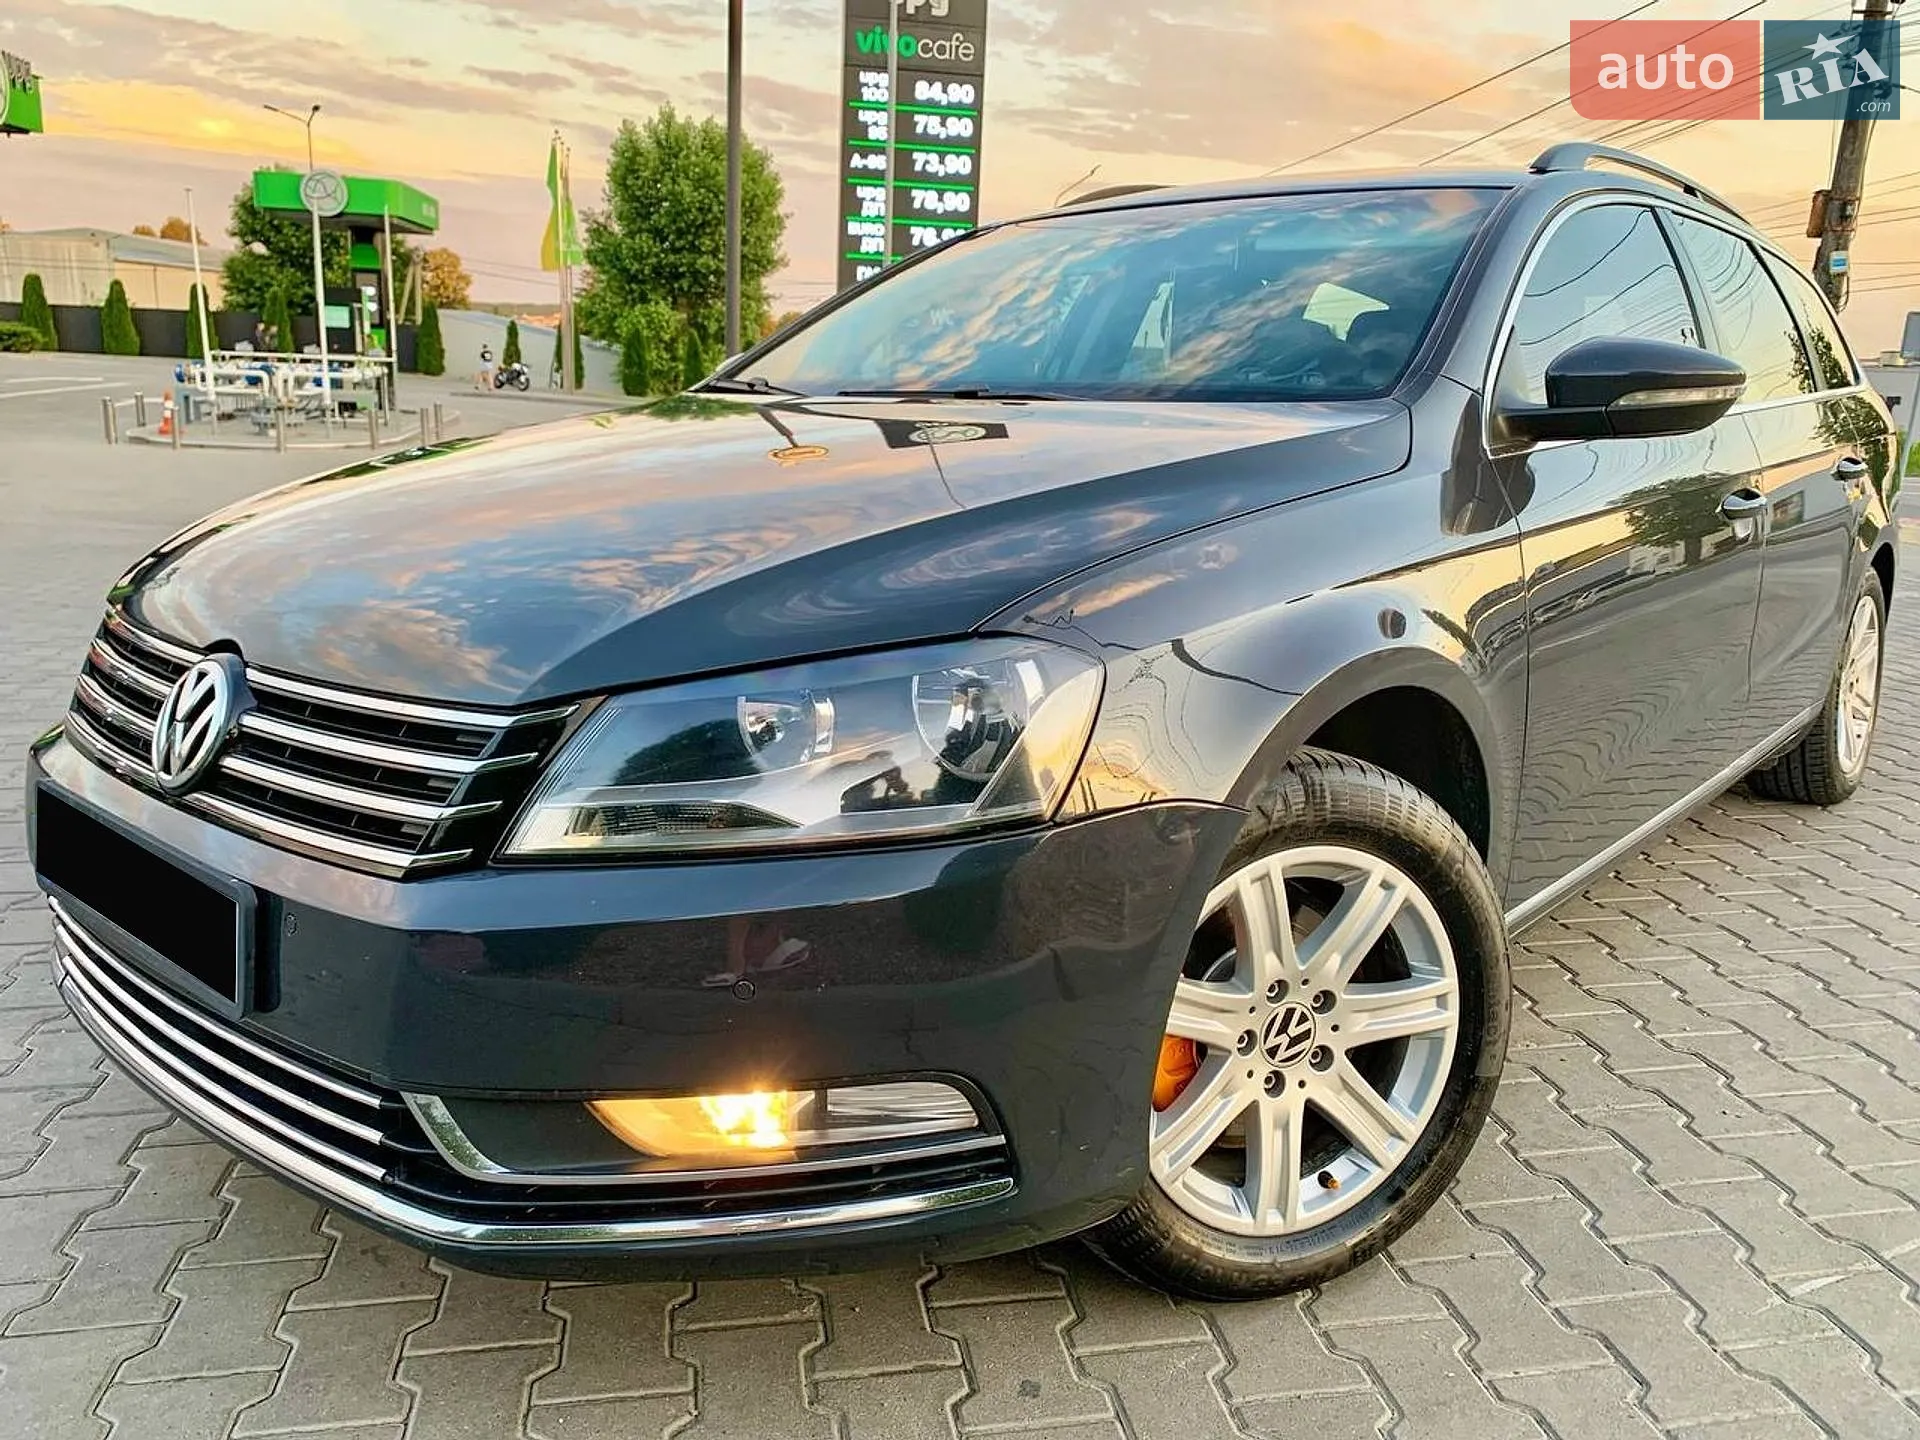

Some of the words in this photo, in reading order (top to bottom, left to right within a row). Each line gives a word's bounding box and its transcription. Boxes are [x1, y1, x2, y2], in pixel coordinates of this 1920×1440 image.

[861, 86, 889, 102] 100
[915, 80, 975, 105] 84,90
[914, 114, 974, 139] 75,90
[912, 152, 972, 177] 73,90
